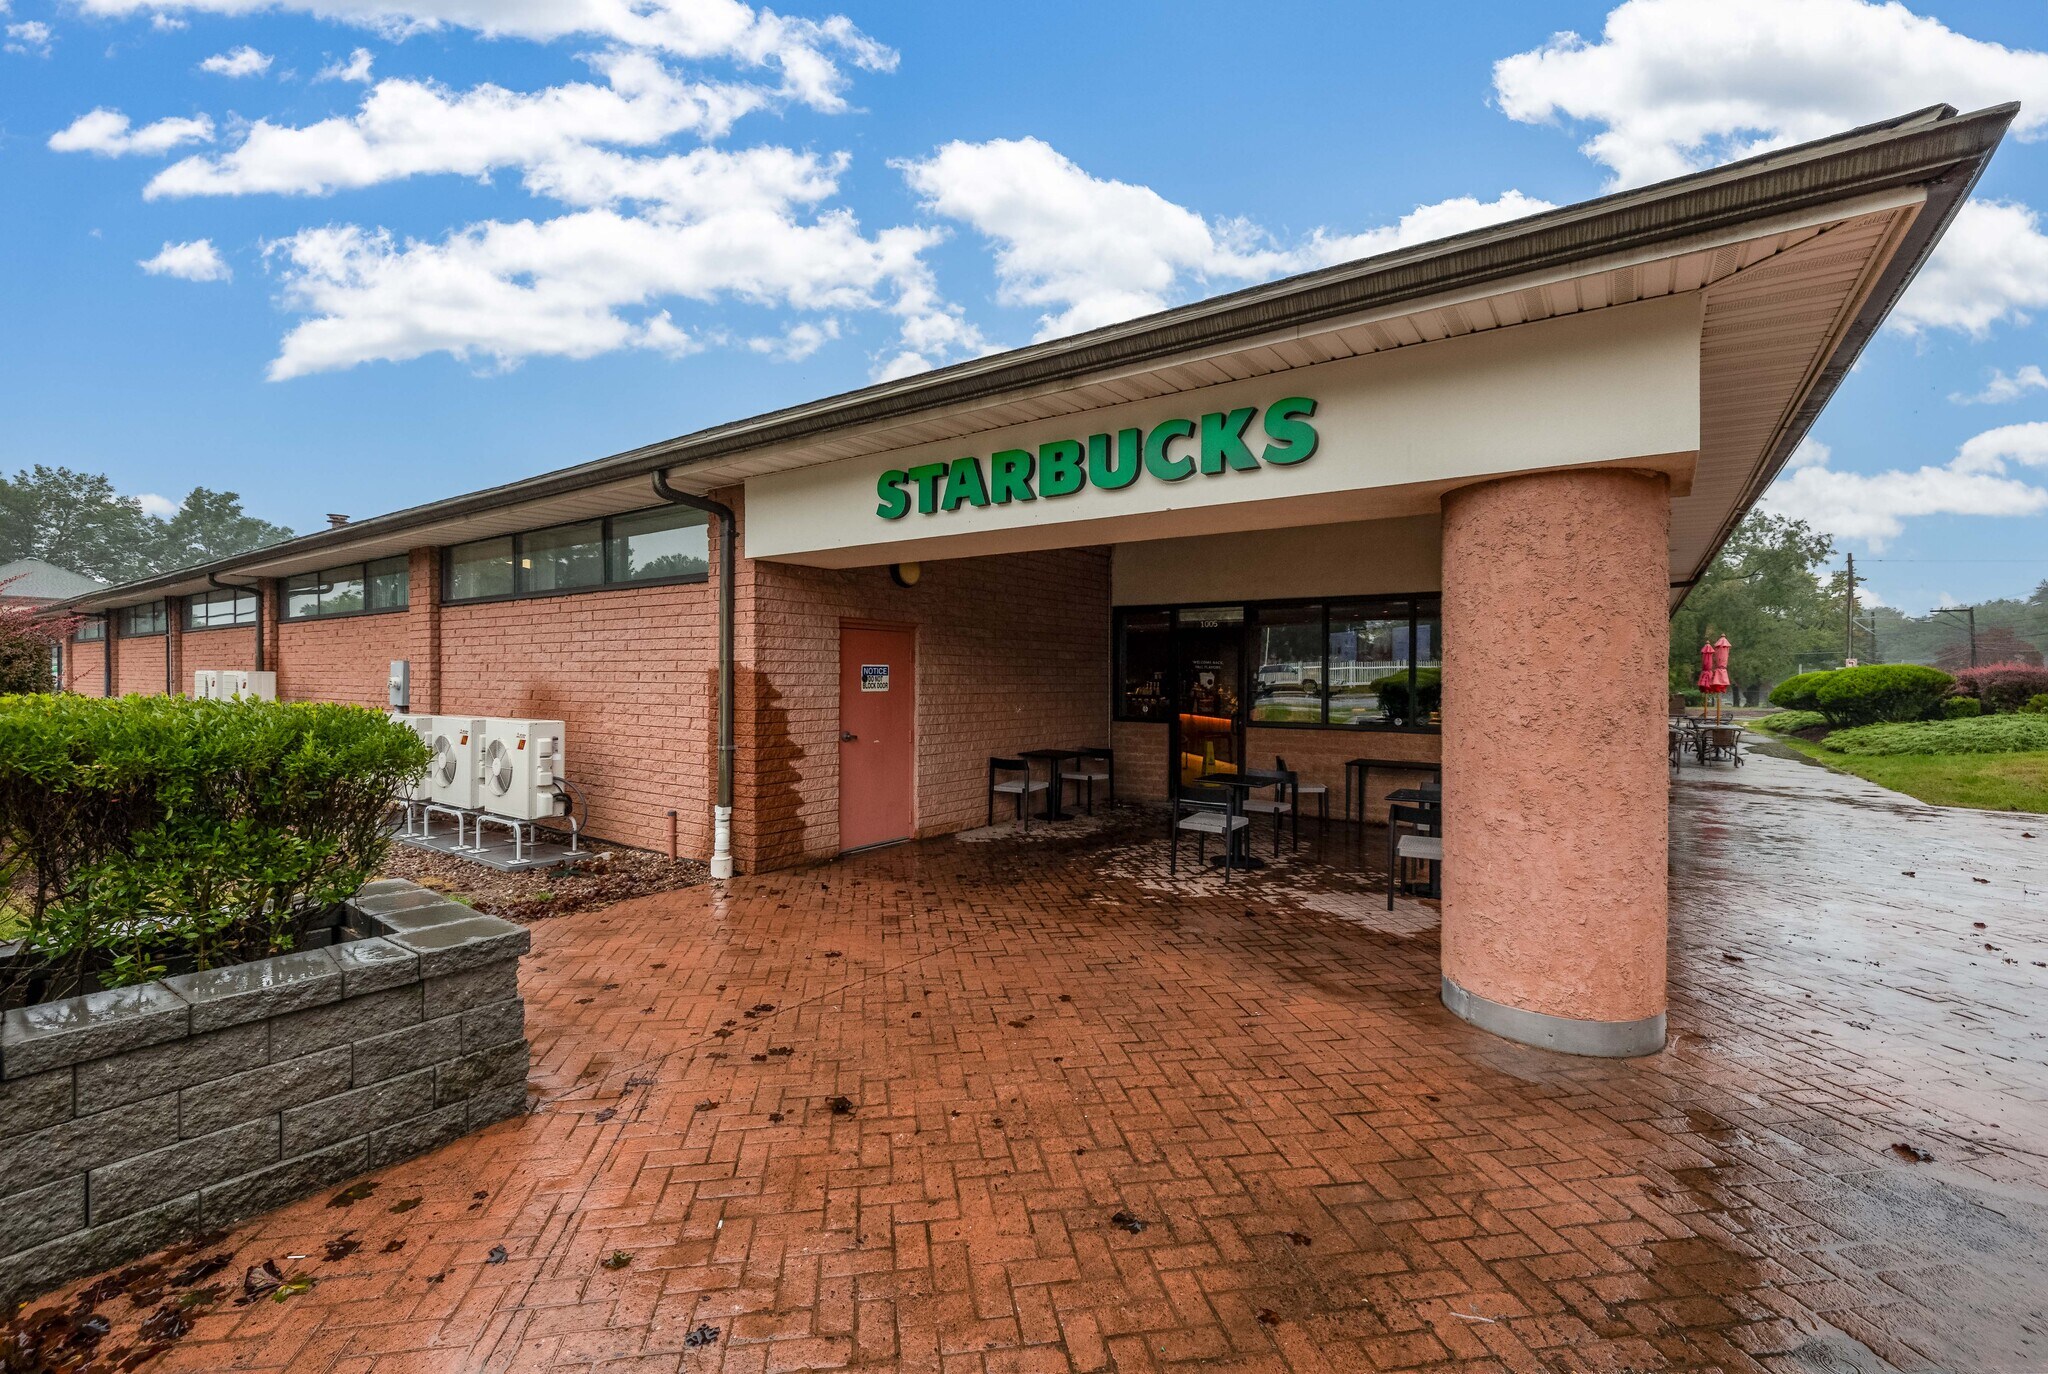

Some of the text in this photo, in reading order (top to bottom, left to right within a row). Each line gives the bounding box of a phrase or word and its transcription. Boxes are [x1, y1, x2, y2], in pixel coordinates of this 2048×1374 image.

[876, 397, 1318, 520] STARBUCKS
[1201, 620, 1218, 628] 1005
[863, 667, 887, 675] NOTICE
